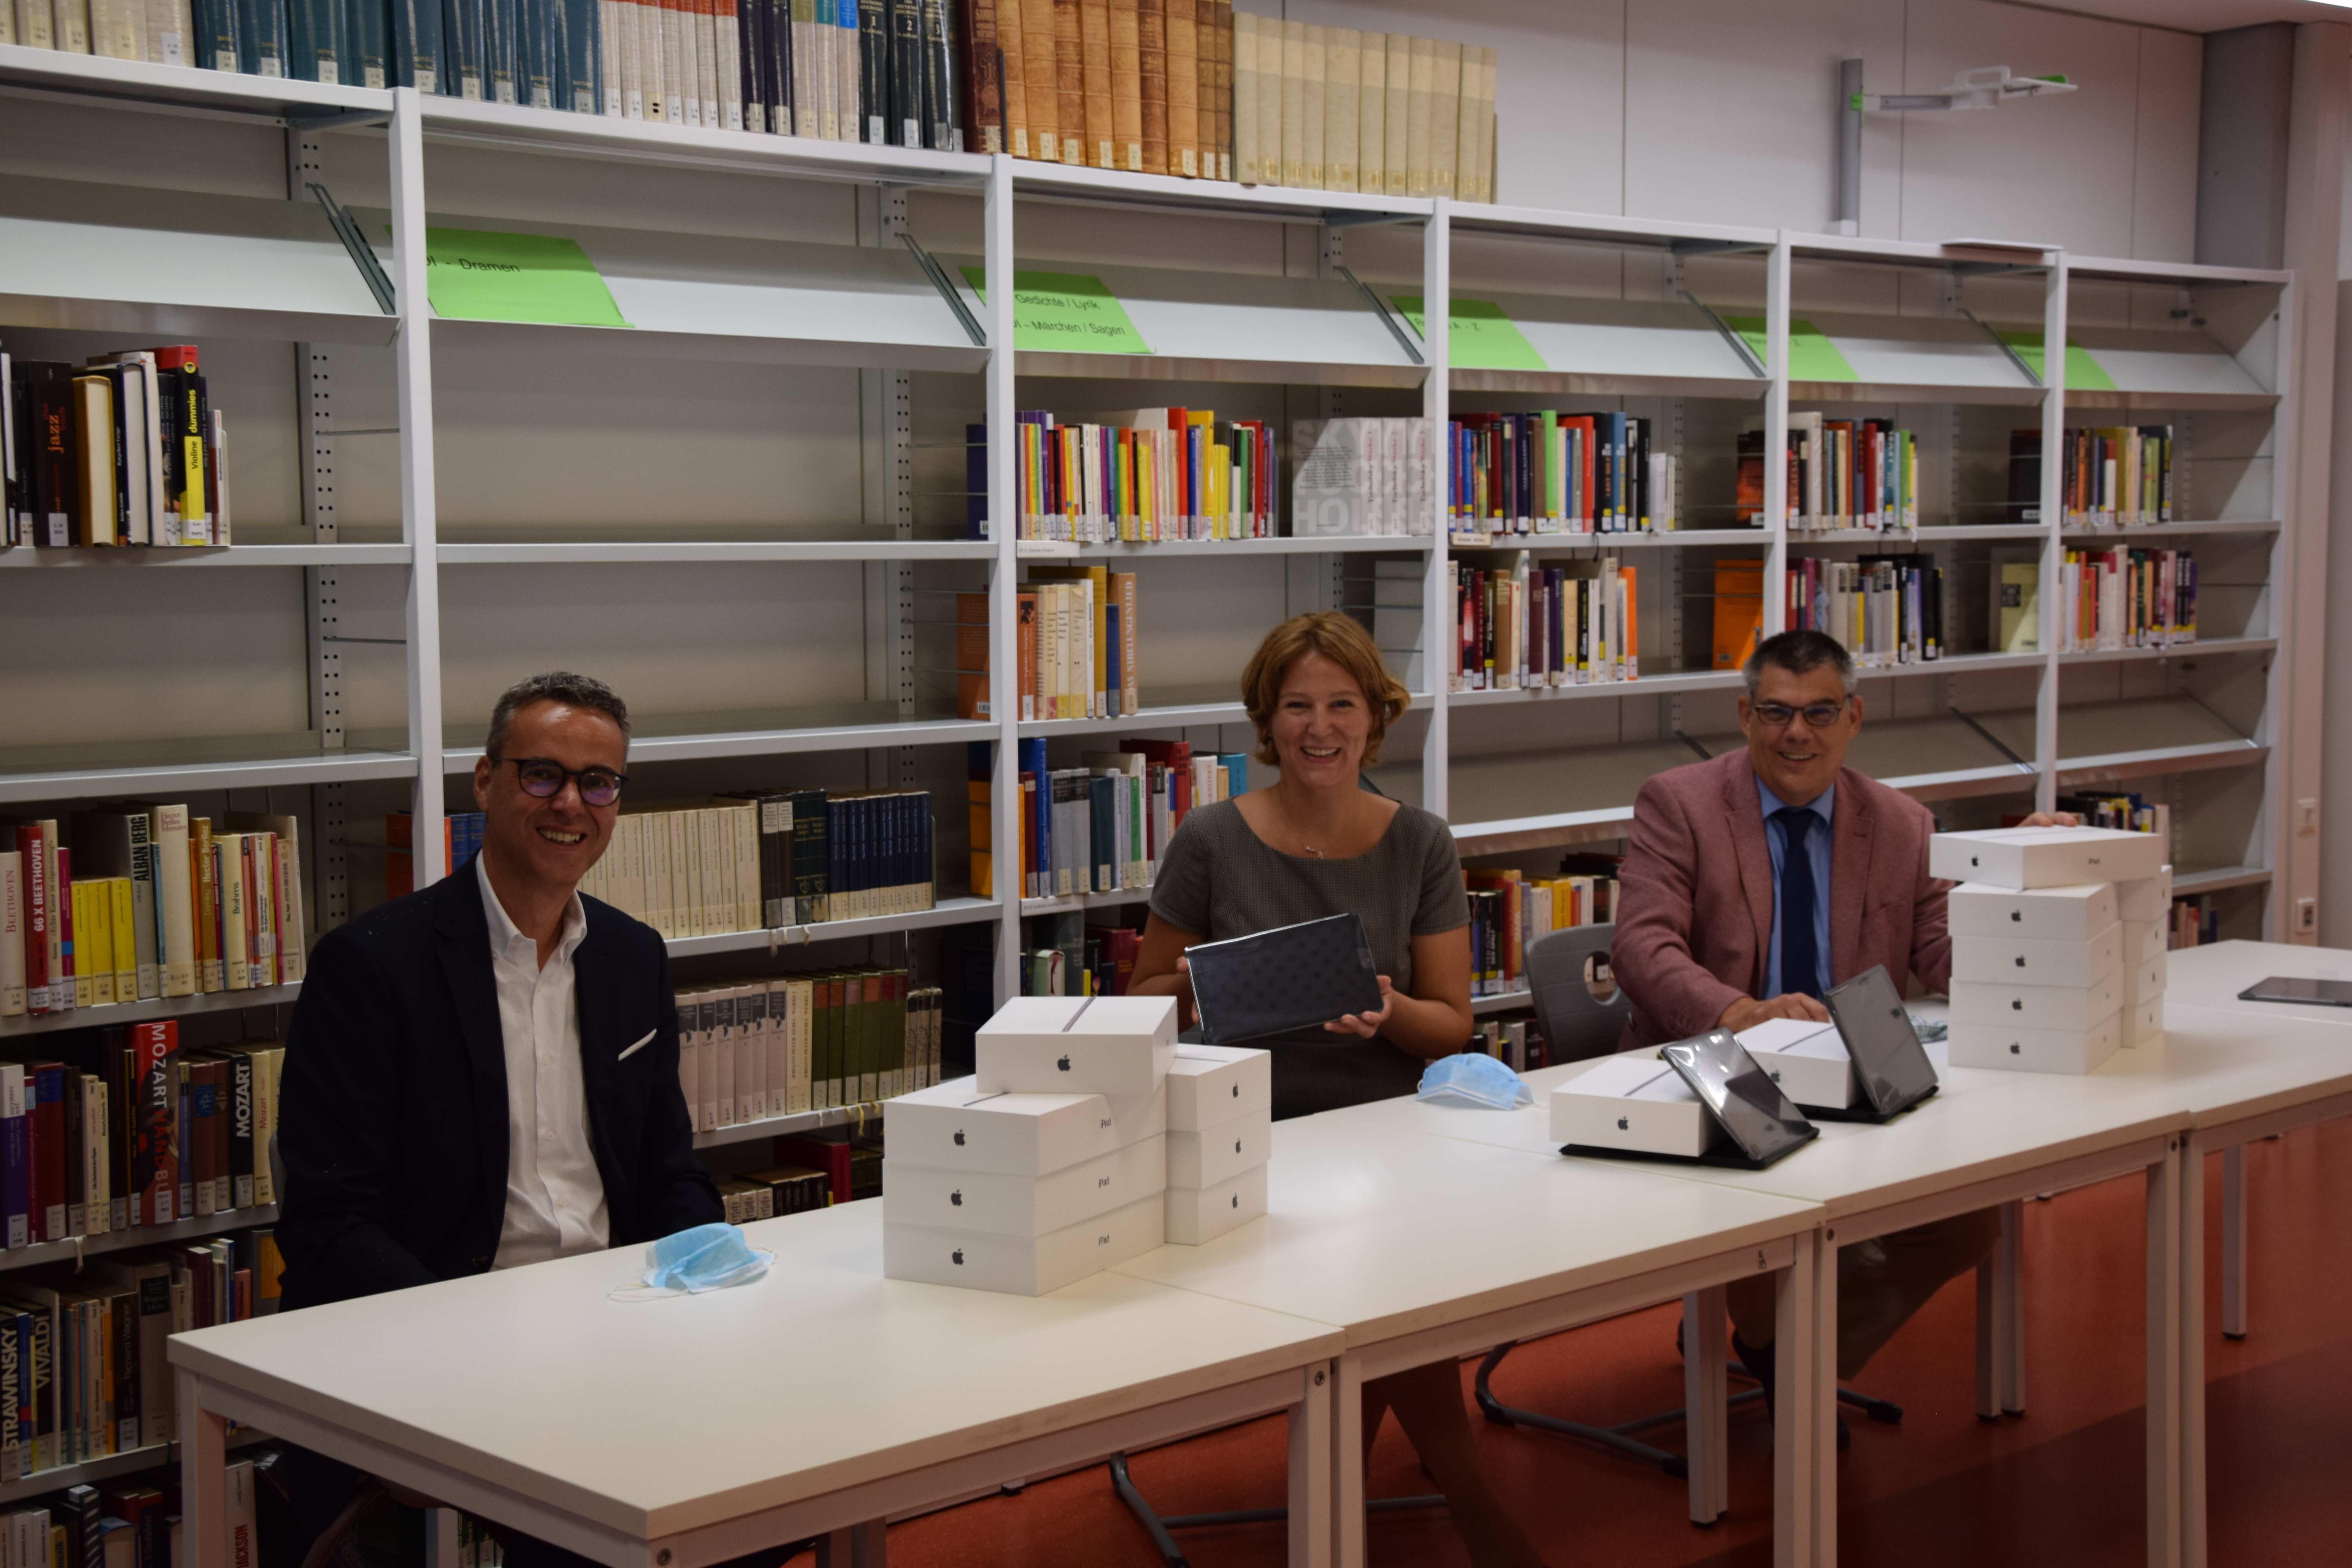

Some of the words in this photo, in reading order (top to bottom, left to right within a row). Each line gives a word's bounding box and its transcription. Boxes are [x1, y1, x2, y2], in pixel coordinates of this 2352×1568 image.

[870, 16, 876, 26] 1
[906, 20, 913, 31] 2
[459, 258, 520, 272] Dramen
[1015, 293, 1064, 307] Gedichte
[1074, 298, 1101, 310] Lyrik
[1032, 321, 1082, 332] Märchen
[1091, 324, 1125, 337] Sagen
[58, 406, 66, 430] buch
[188, 389, 198, 433] dummies
[47, 414, 65, 454] jazz
[1125, 581, 1134, 672] NIBELUNGENLIED
[131, 816, 149, 844] BERG
[201, 825, 209, 853] Berlioz
[31, 839, 44, 905] BEETHOVEN
[134, 846, 150, 881] ALBAN
[202, 855, 211, 882] Hector
[6, 870, 16, 933] BEETHOVEN
[34, 907, 44, 915] X
[34, 918, 44, 932] 66
[151, 1024, 167, 1108] MOZART
[235, 1063, 250, 1137] MOZART
[1100, 1117, 1111, 1128] iPad
[1098, 1176, 1110, 1188] iPad
[1098, 1234, 1110, 1246] iPad
[143, 1295, 169, 1303] Wagners
[147, 1303, 165, 1312] Hitler
[123, 1303, 132, 1340] Wagner
[35, 1315, 51, 1390] VIVALDI
[123, 1342, 132, 1379] Richard
[2, 1328, 19, 1449] STRAWINSKY
[142, 1514, 152, 1560] Filmführer
